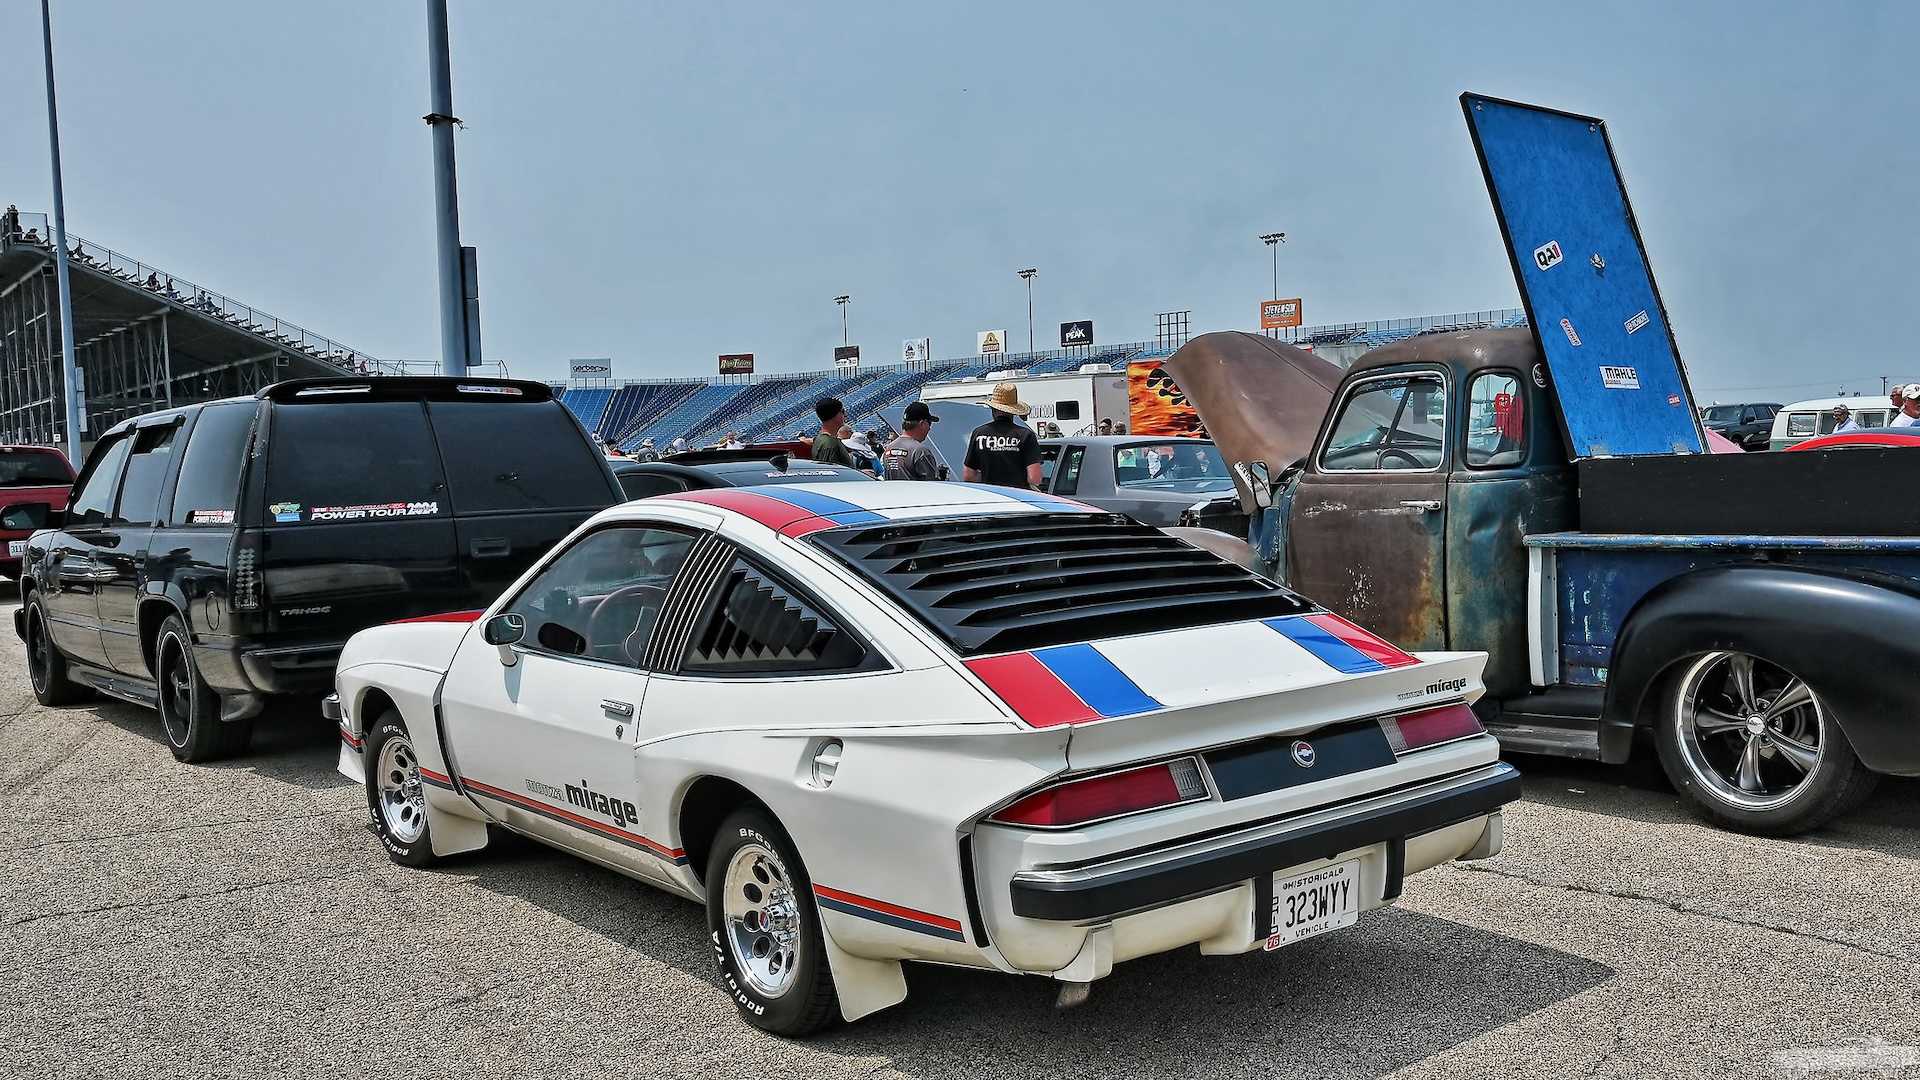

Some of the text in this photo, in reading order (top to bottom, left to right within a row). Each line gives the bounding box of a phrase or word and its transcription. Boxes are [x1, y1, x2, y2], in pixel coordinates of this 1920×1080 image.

[1537, 243, 1561, 267] QA1
[1065, 328, 1086, 342] PEAK
[1605, 367, 1637, 380] MAHLE
[976, 435, 1020, 450] THOLEY
[311, 510, 366, 520] POWER
[368, 508, 407, 517] TOUR
[406, 501, 438, 515] 2024
[280, 606, 331, 616] TAHOE
[1426, 678, 1467, 695] mirage
[565, 779, 639, 828] mirage
[1286, 879, 1350, 928] 323WYY
[1295, 921, 1329, 937] VEHICLE
[1268, 938, 1279, 949] 76
[712, 930, 764, 1015] Radial T/A
